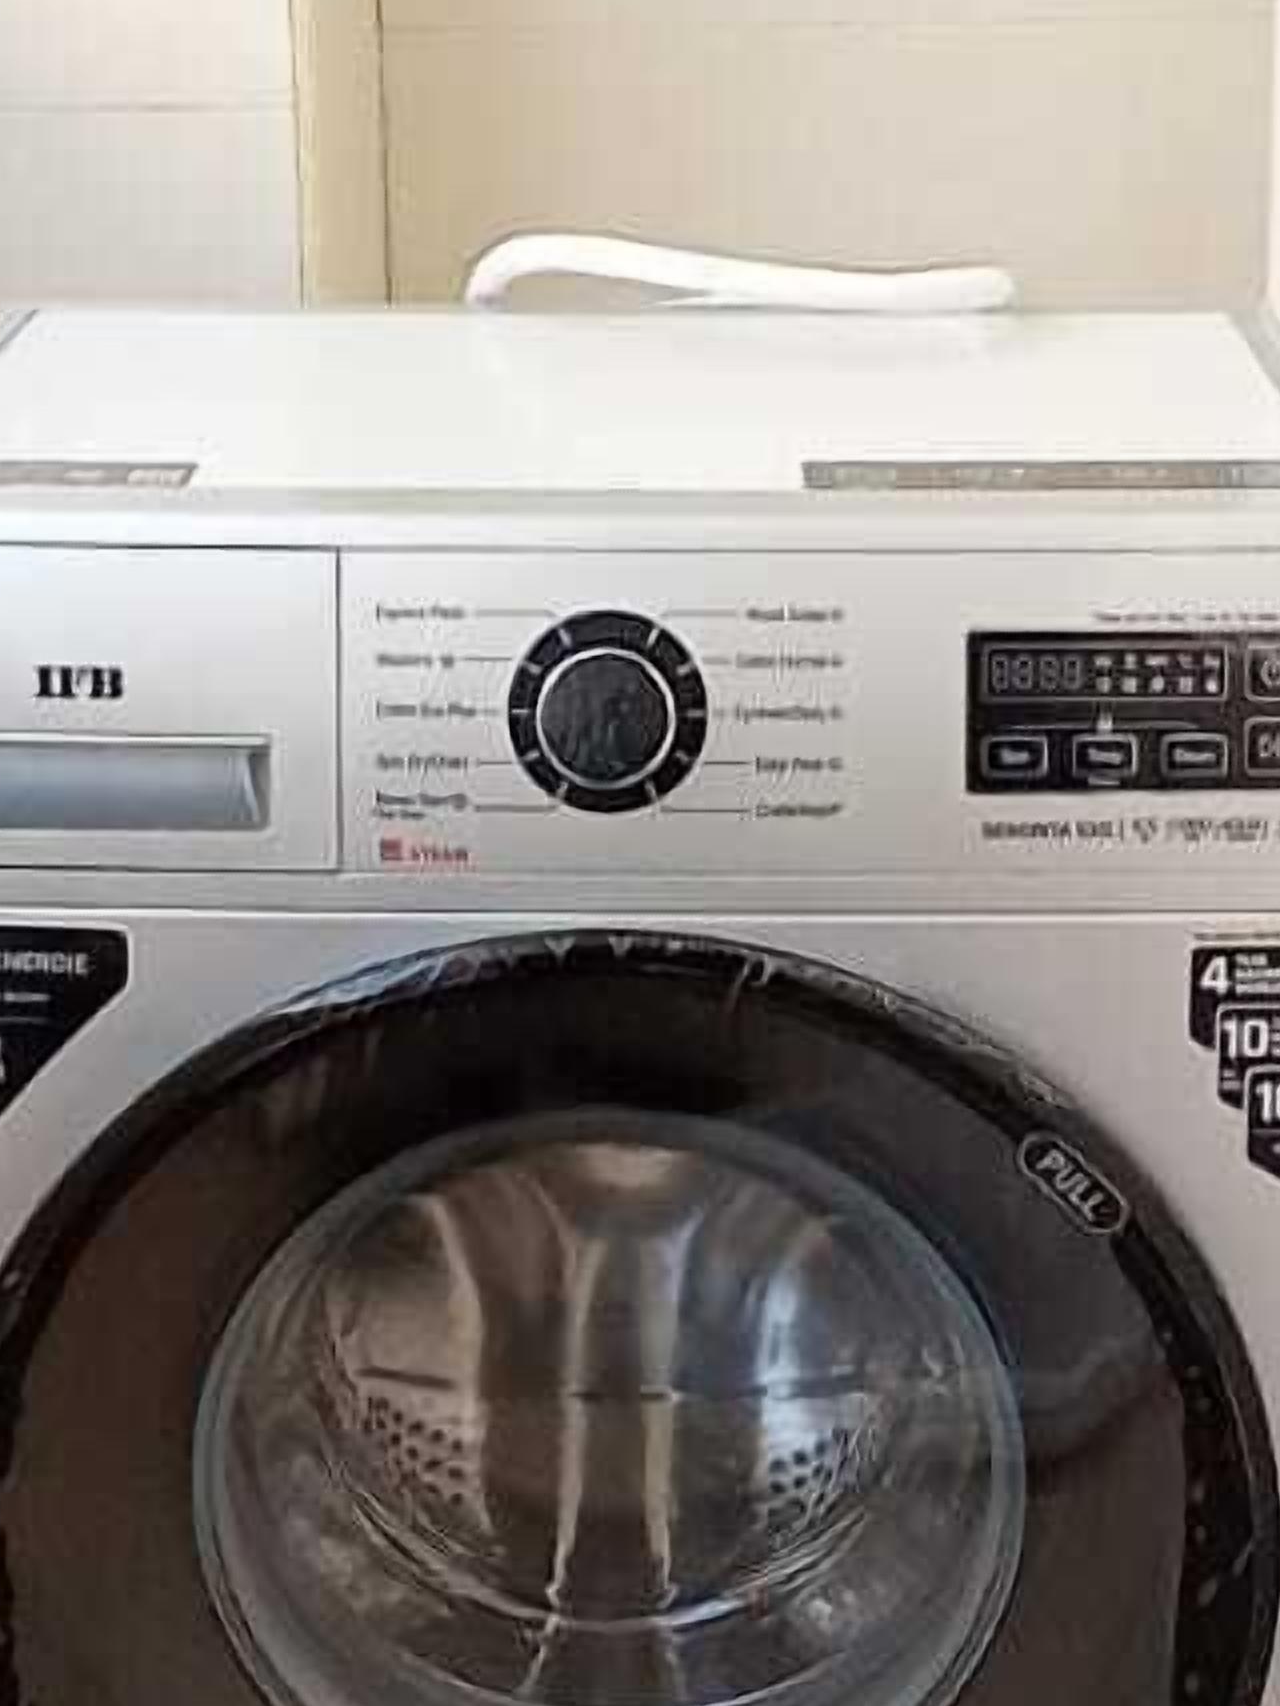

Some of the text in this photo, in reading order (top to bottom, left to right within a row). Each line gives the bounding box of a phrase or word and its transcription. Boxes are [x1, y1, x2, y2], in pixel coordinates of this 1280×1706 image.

[1200, 954, 1231, 995] 4
[1223, 1017, 1269, 1059] 10
[1035, 1148, 1104, 1222] PULL
